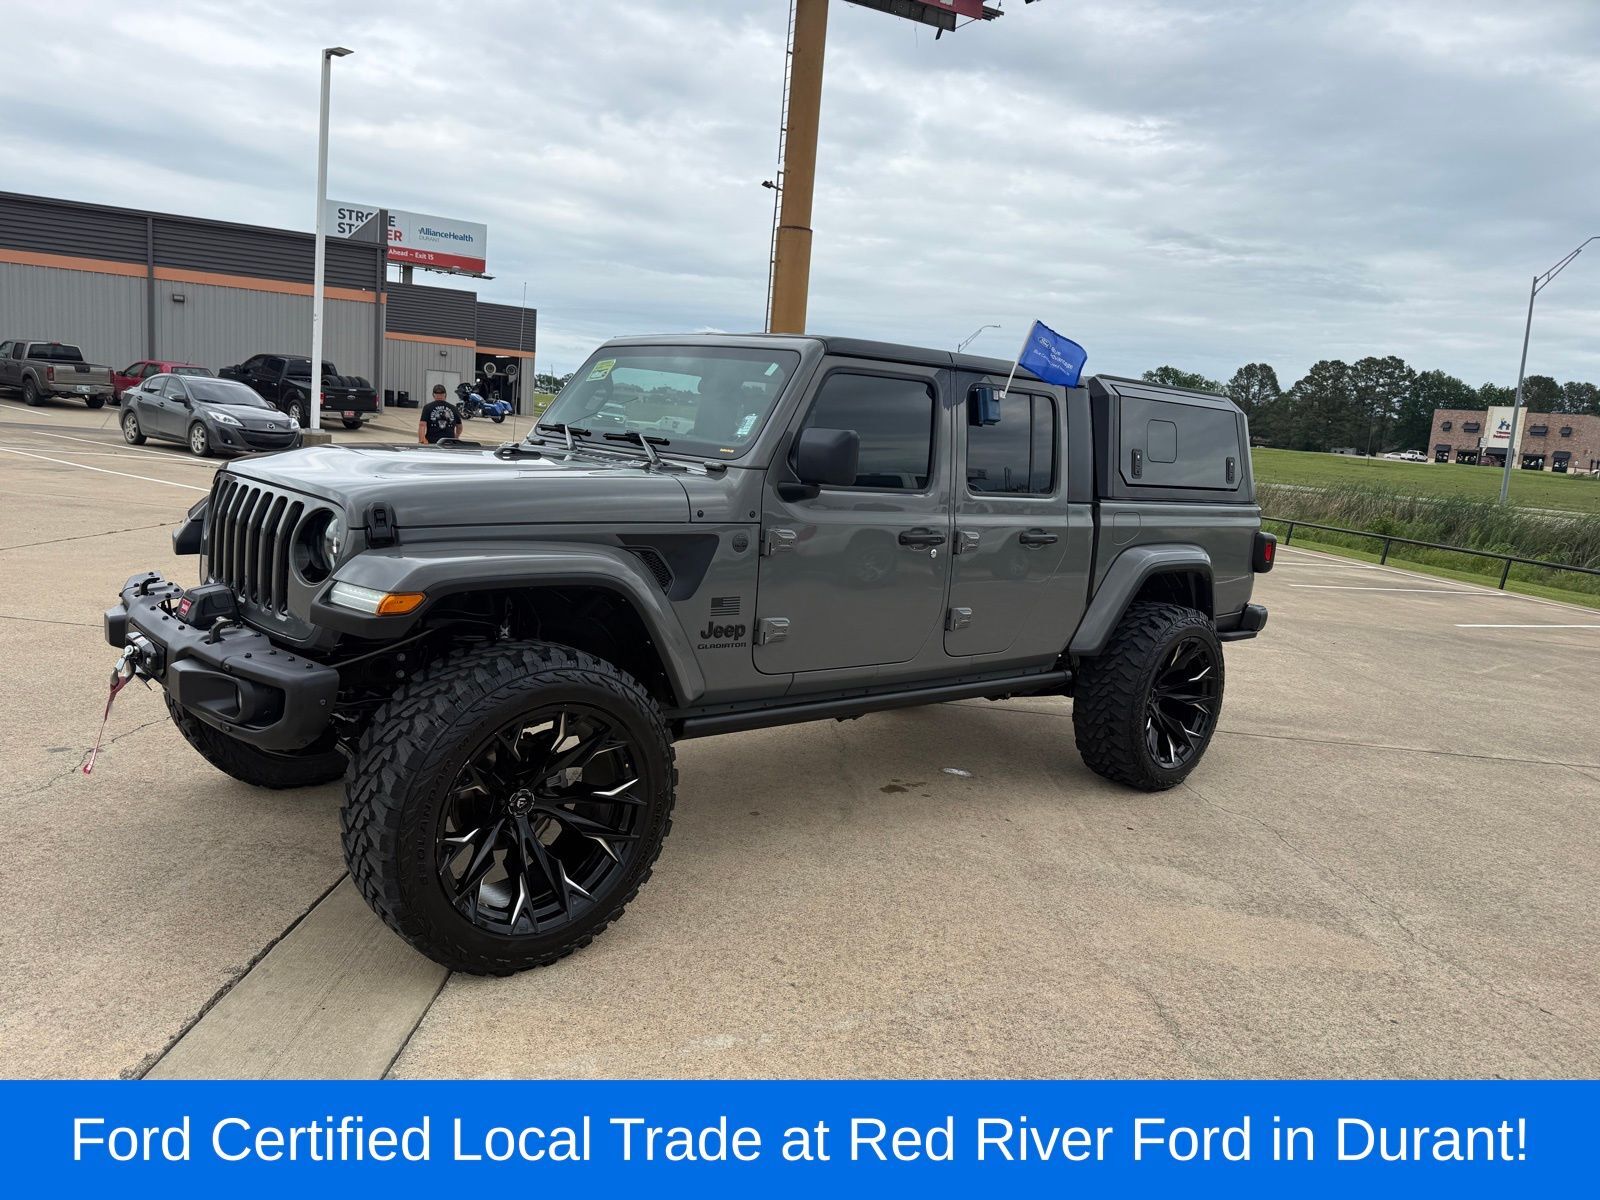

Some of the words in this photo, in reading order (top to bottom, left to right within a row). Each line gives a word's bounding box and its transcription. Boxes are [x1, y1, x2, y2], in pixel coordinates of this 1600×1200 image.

[338, 208, 396, 227] STROE
[338, 222, 403, 242] STER
[419, 227, 474, 242] AllianceHealth
[419, 235, 440, 243] DURANT
[388, 248, 409, 257] Ahead
[415, 251, 427, 260] Exit
[427, 253, 434, 261] 15
[700, 621, 746, 641] Jeep
[697, 642, 747, 650] GLADIATOR
